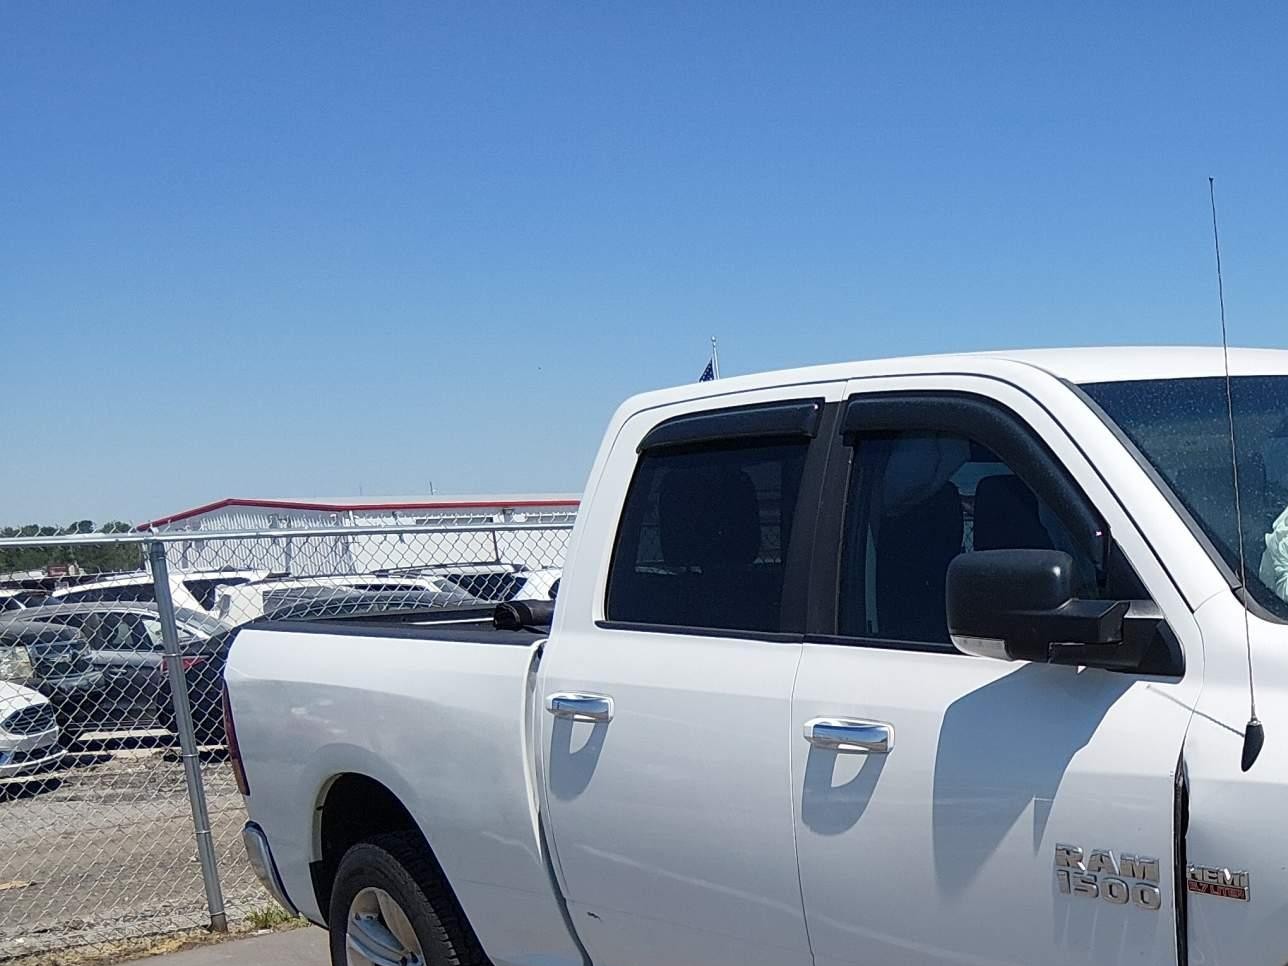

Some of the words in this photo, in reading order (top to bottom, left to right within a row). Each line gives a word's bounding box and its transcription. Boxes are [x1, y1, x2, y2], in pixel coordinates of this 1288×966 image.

[1055, 843, 1160, 882] RAM
[1187, 864, 1250, 887] HEMI
[1056, 869, 1162, 910] 1500
